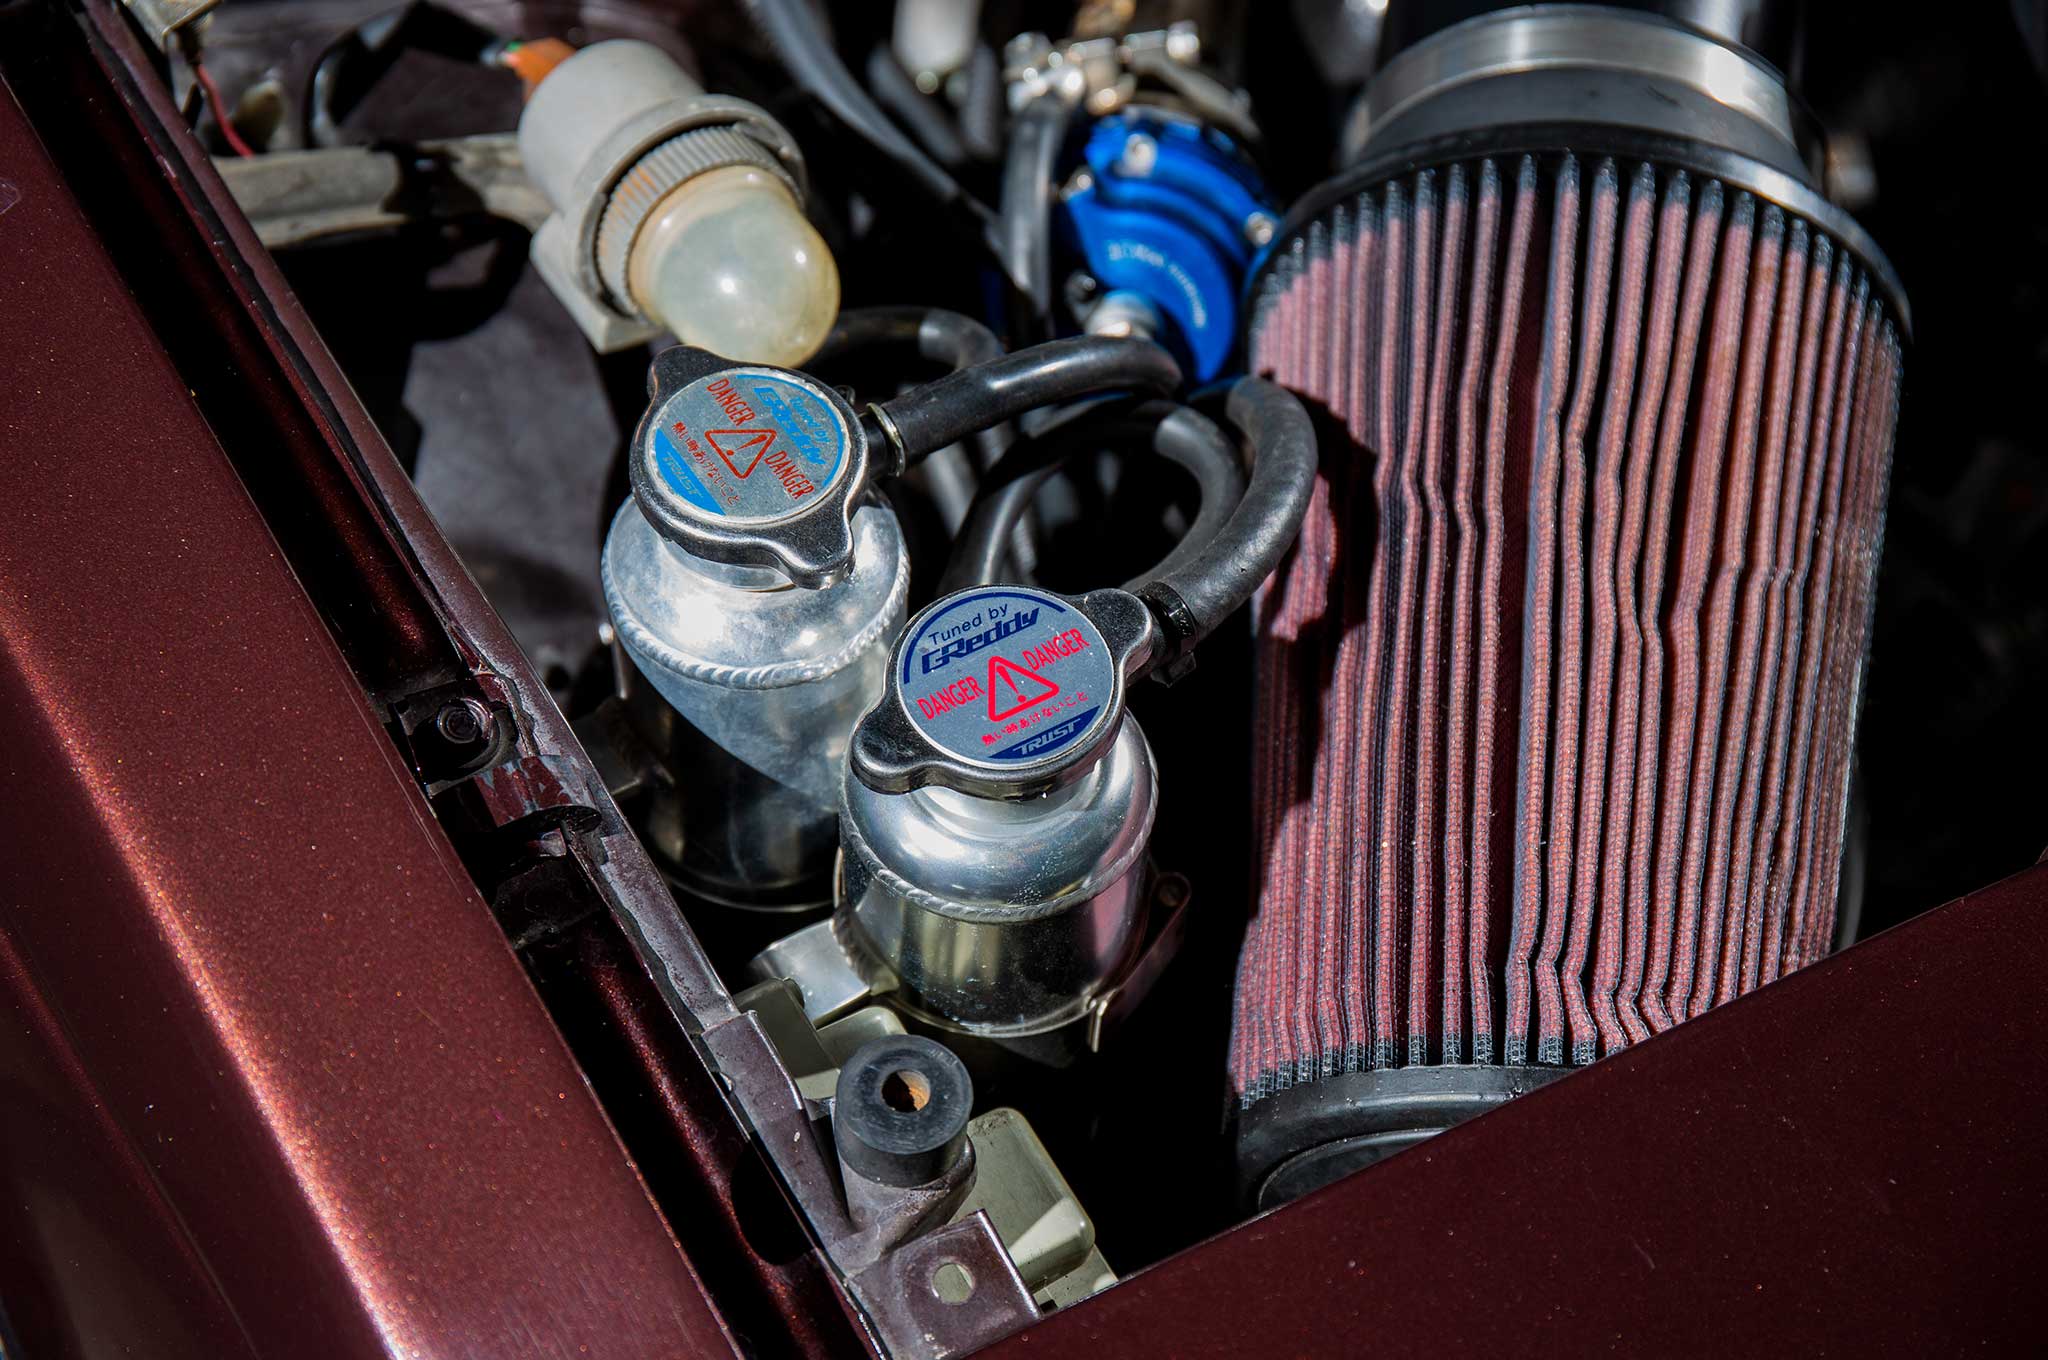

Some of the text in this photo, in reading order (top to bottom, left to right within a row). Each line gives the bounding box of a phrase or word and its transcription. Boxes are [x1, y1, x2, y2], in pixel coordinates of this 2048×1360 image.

[706, 377, 815, 500] DANGER DANGER
[662, 451, 705, 498] TRUST
[922, 607, 1040, 675] GReddy
[928, 603, 1009, 645] Tuned by
[917, 627, 1091, 720] DANGER DANGER
[1012, 717, 1081, 755] TRUST
